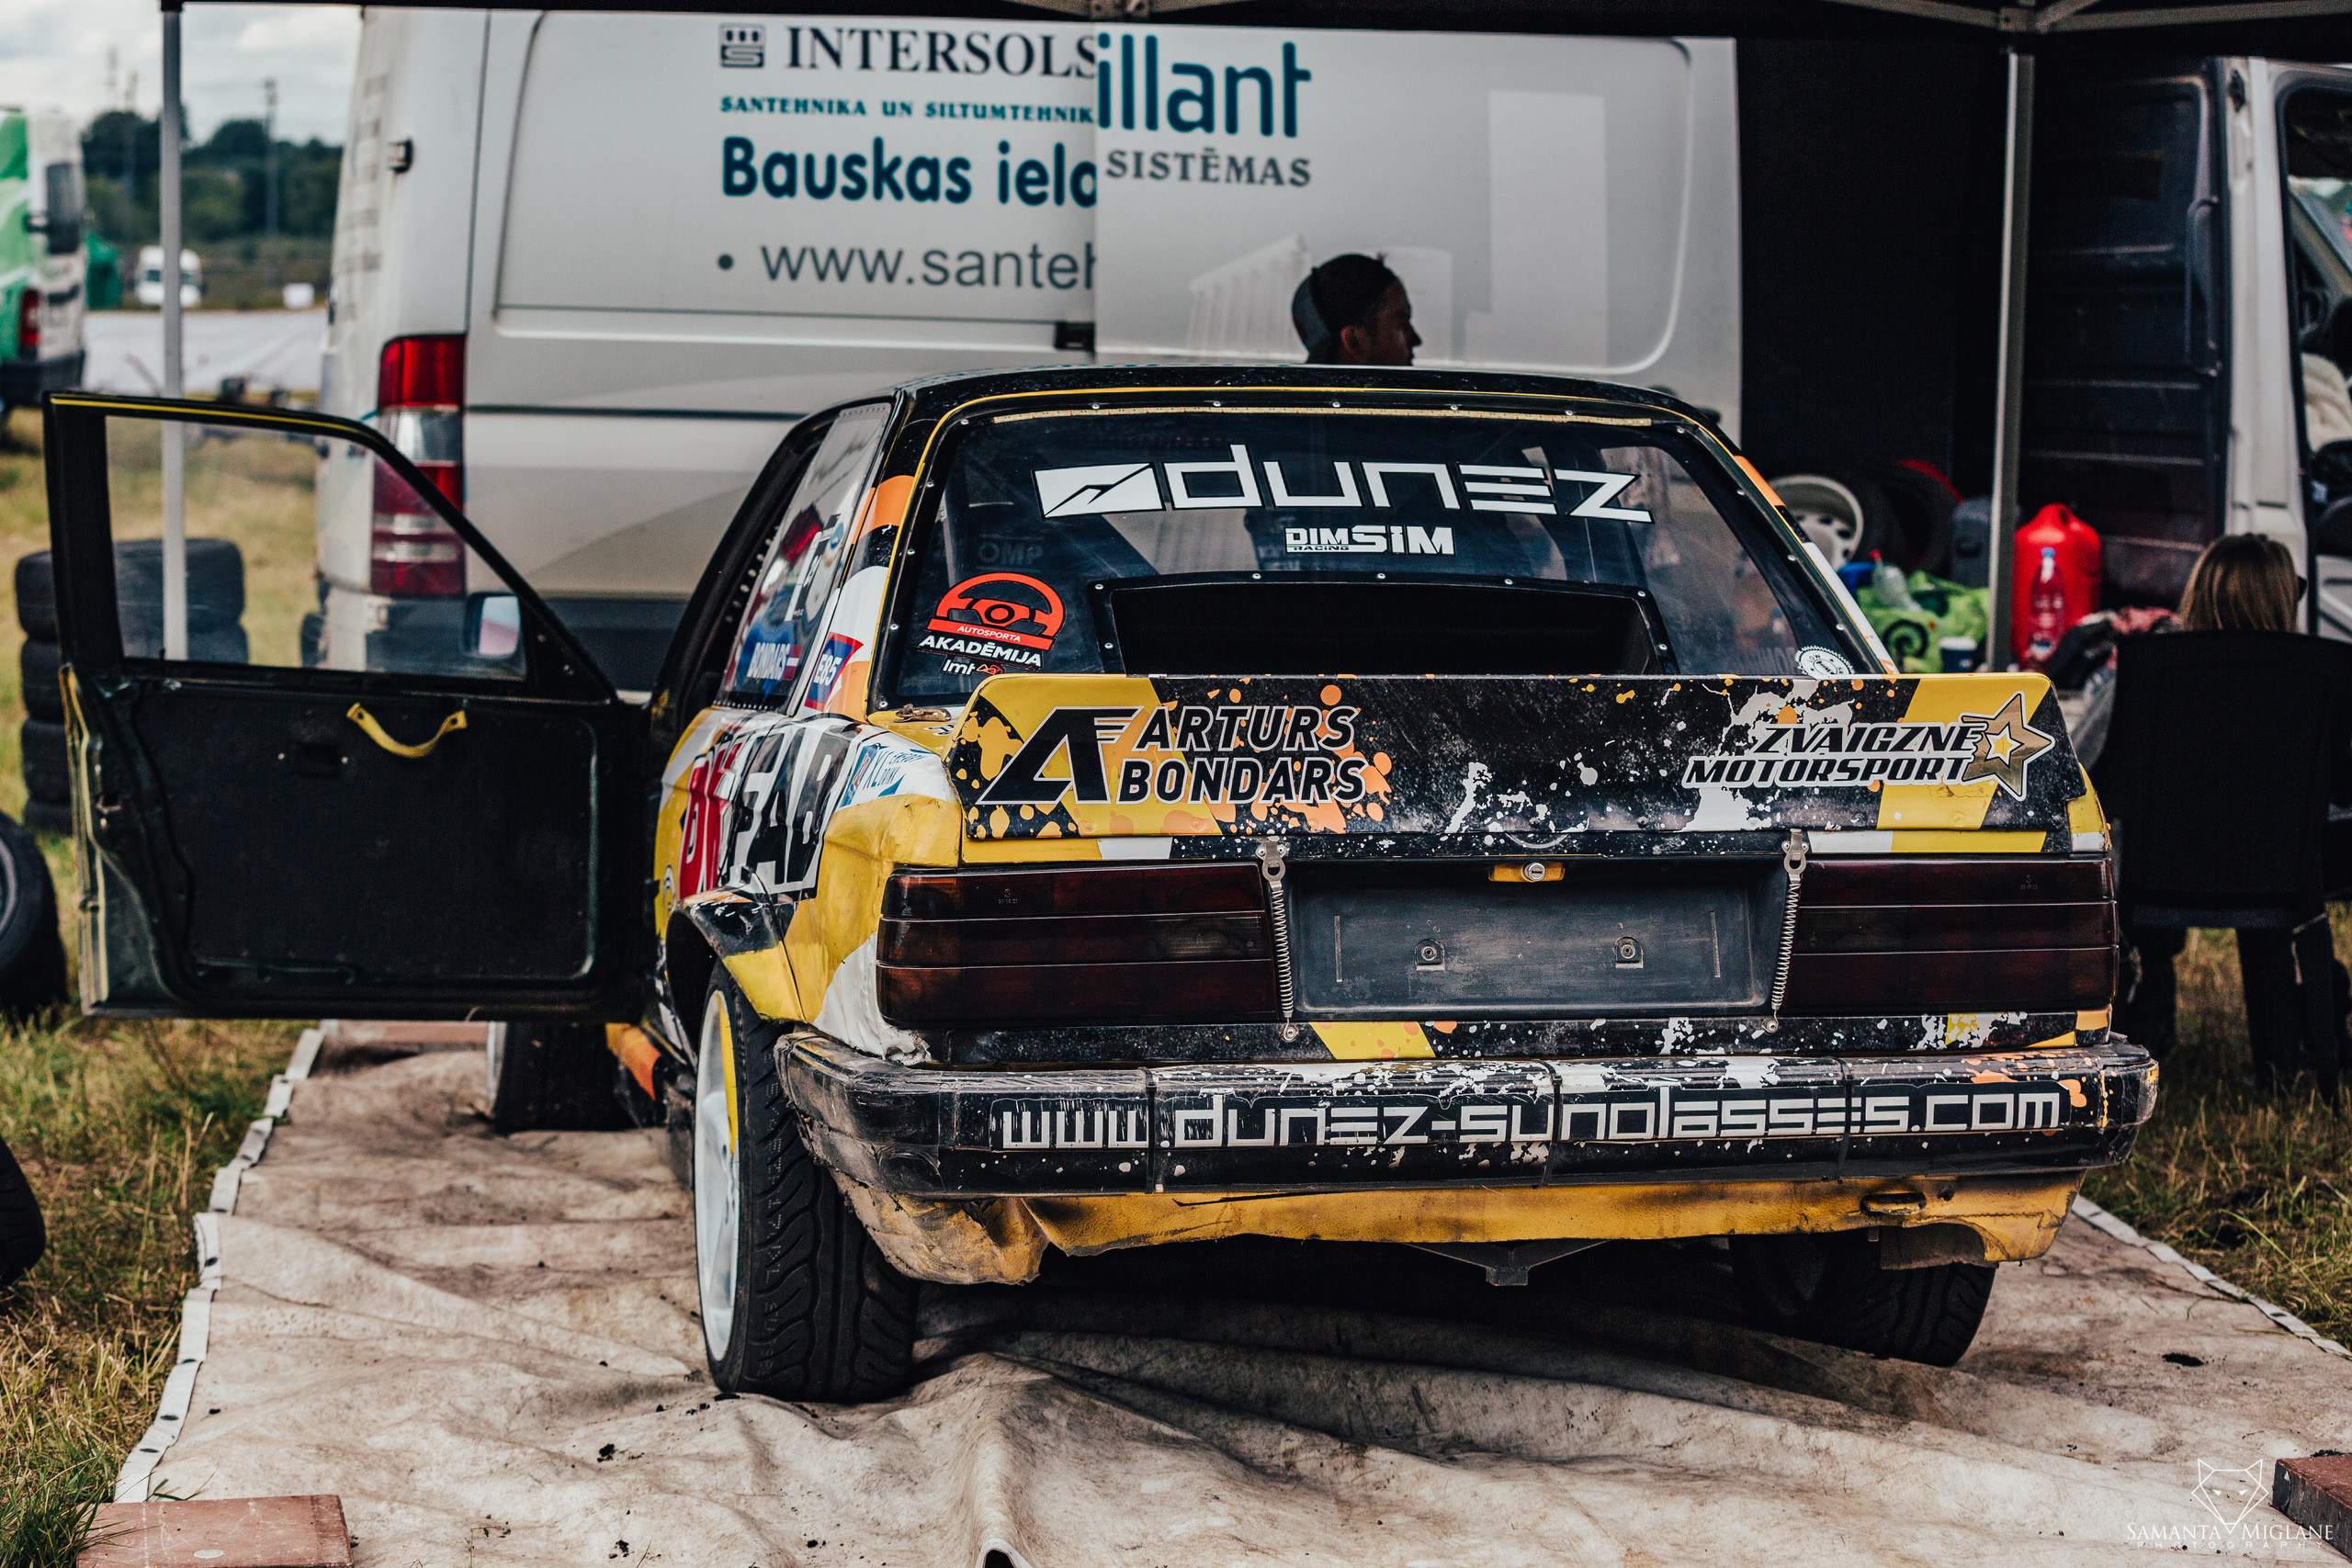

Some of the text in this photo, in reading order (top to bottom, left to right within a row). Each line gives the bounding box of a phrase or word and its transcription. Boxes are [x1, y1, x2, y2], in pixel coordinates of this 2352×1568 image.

[786, 26, 1095, 79] INTERSOLS
[720, 96, 867, 117] SANTEHNIKA
[882, 100, 913, 118] UN
[722, 136, 972, 204] Bauskas
[1106, 147, 1312, 186] SISTĒMAS
[919, 635, 1042, 667] AKADĒMIJA
[956, 626, 1021, 643] AUTOSPORTA
[813, 653, 842, 686] E85
[943, 659, 976, 675] lmt
[1131, 705, 1362, 752] ARTURS
[1114, 756, 1370, 805] BONDARS
[1685, 756, 1975, 785] MOTORSPORT
